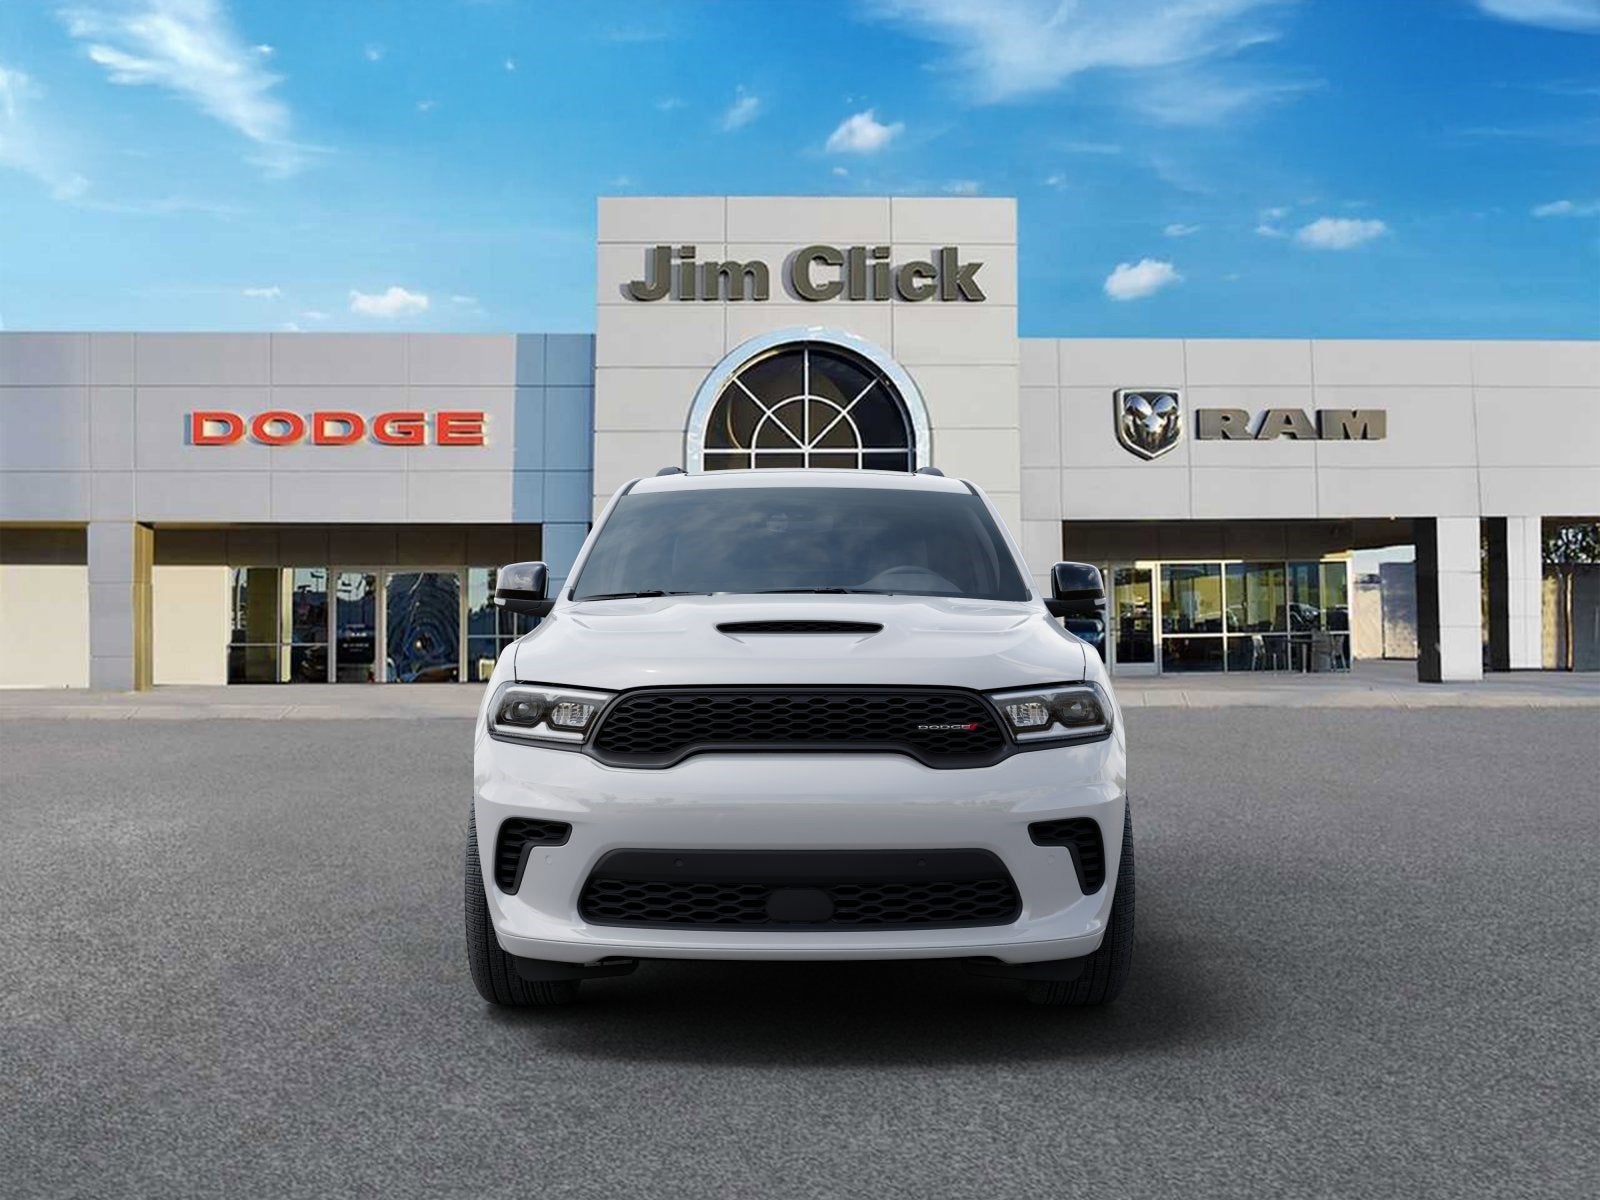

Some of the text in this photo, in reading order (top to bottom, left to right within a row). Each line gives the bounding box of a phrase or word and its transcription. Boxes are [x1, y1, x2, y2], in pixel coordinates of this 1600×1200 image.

[626, 244, 986, 302] Jim Click
[191, 410, 485, 446] DODGE
[1195, 408, 1387, 440] RAM
